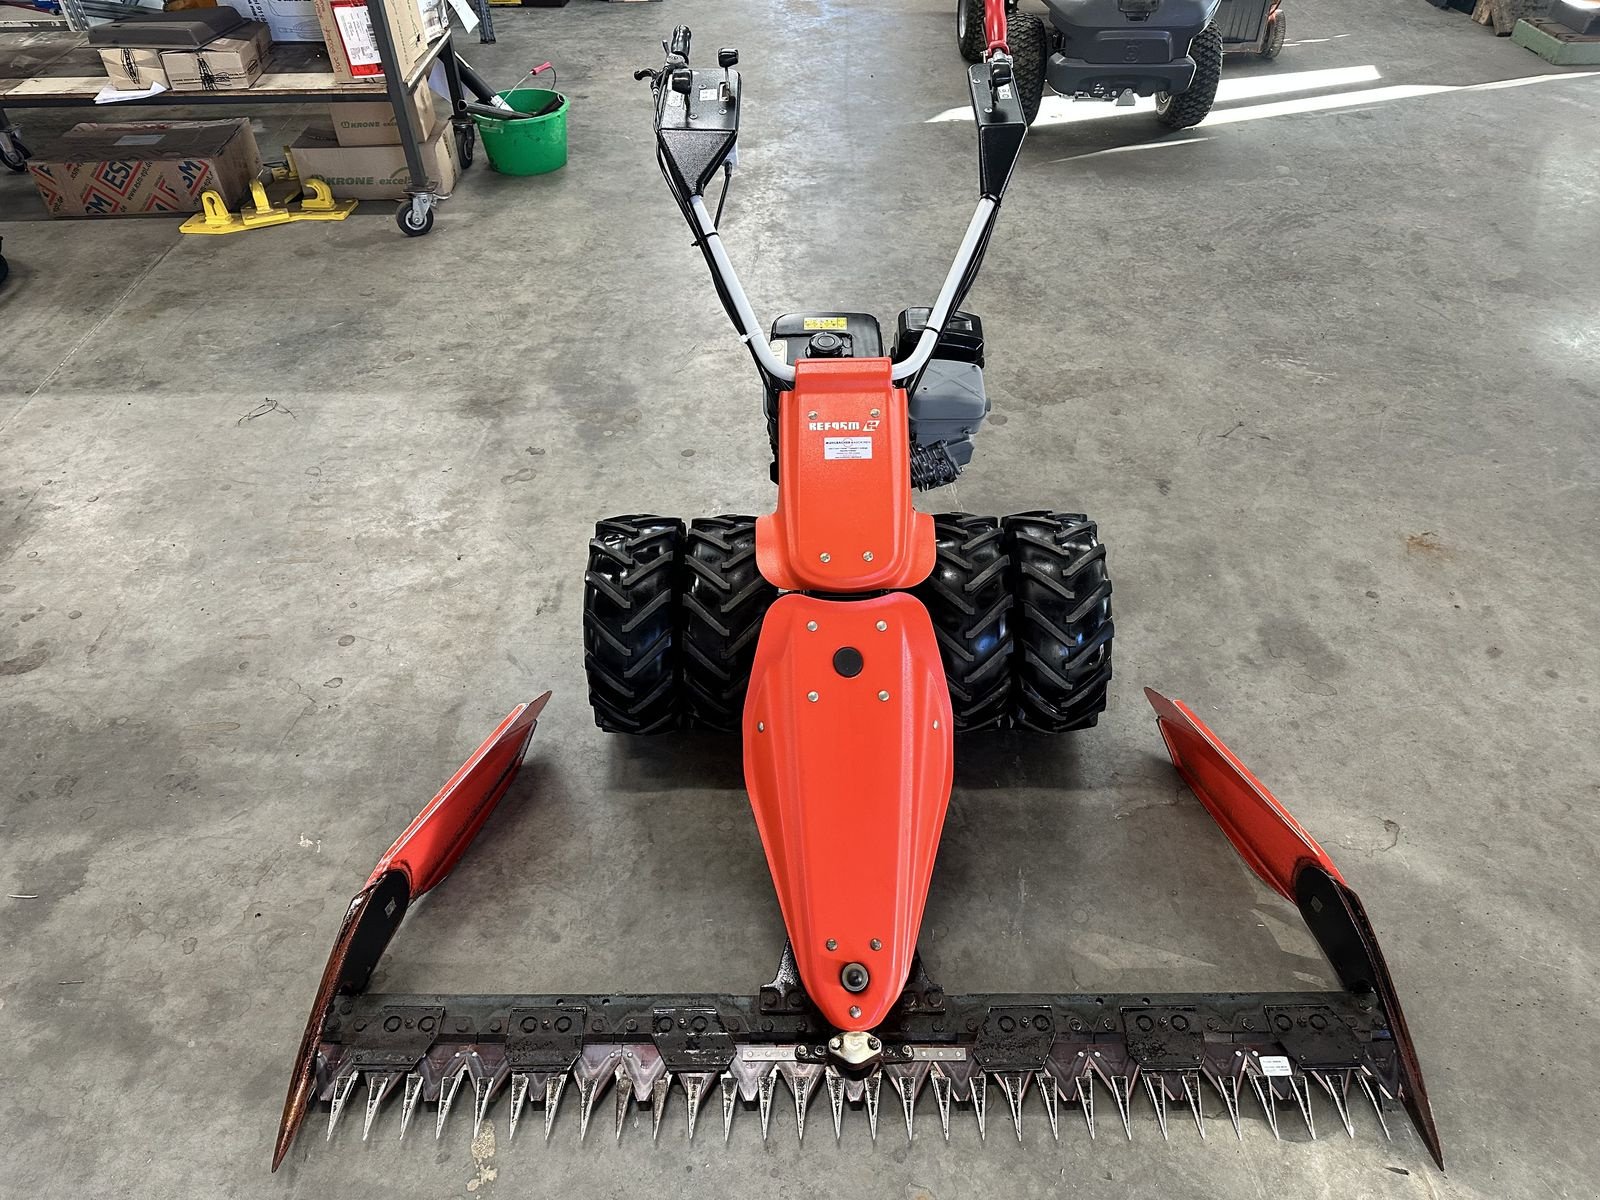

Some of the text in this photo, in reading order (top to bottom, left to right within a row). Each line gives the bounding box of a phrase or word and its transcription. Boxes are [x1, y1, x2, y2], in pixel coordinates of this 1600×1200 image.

[351, 121, 380, 129] KRONE
[326, 176, 374, 186] KRONE
[808, 421, 860, 431] REFORM
